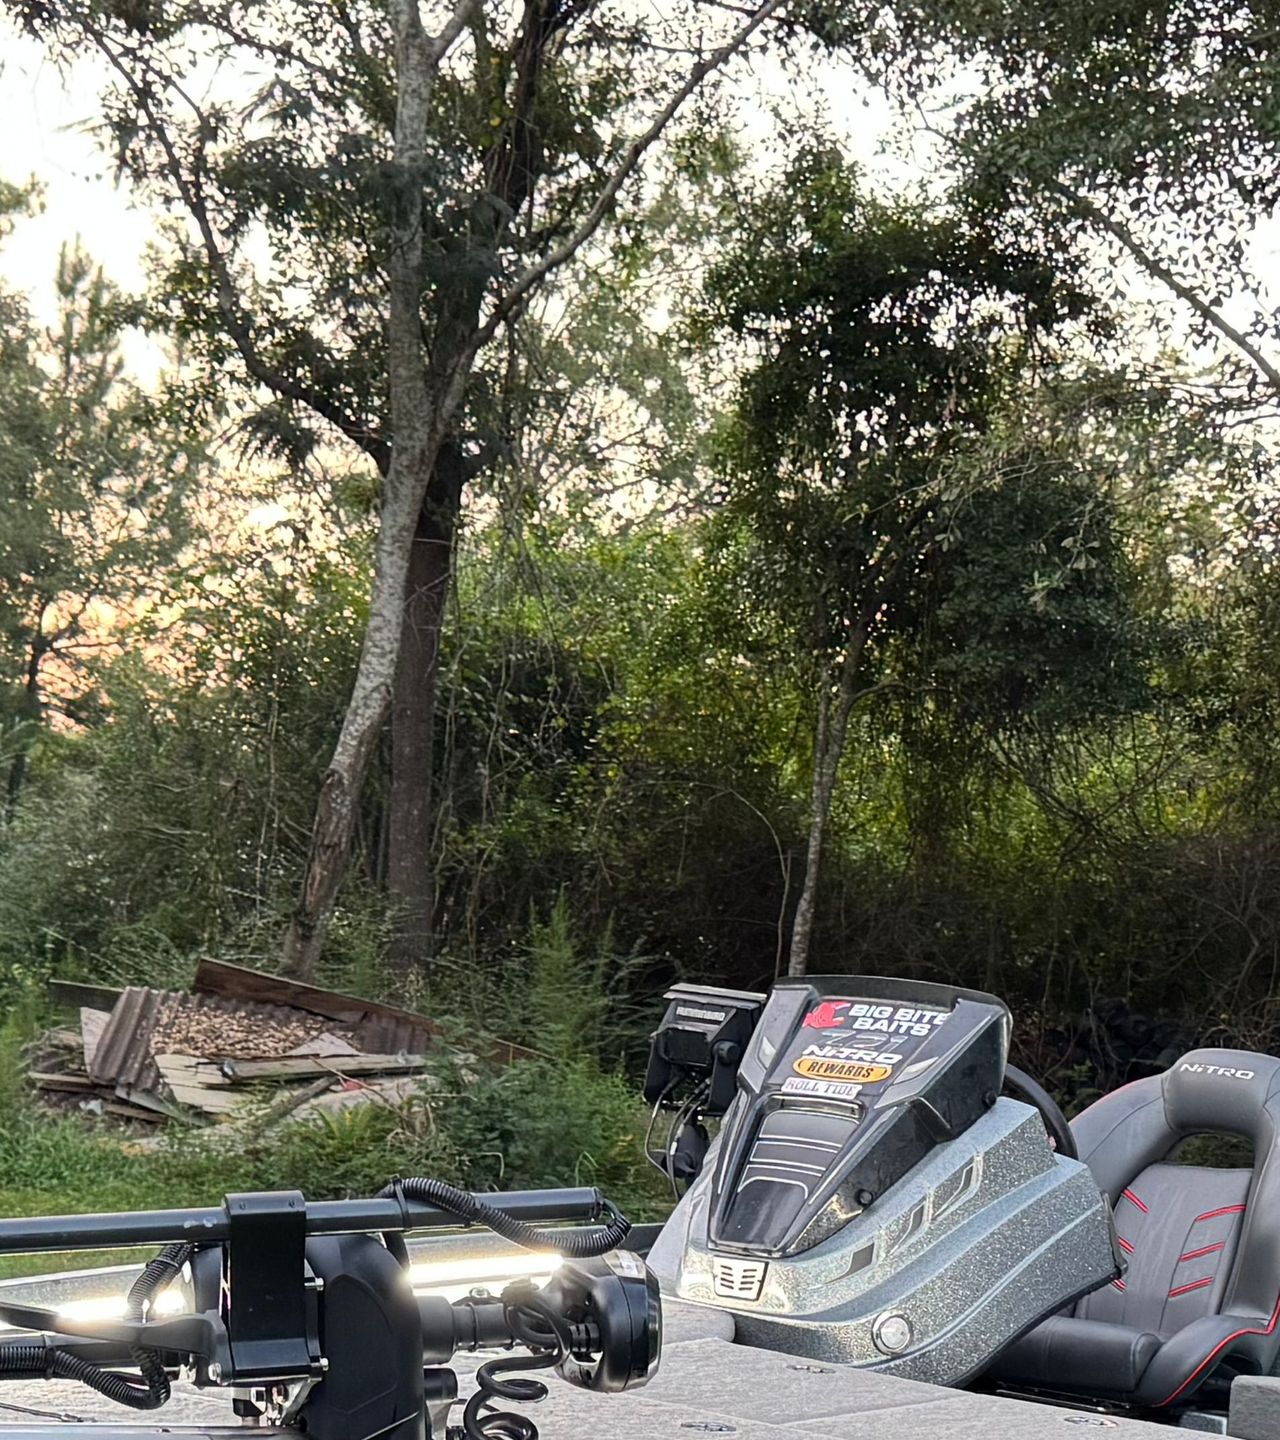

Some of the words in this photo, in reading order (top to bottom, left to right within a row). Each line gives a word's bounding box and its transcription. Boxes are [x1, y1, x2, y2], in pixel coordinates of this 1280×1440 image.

[848, 1004, 895, 1019] BIG
[894, 1007, 952, 1026] BITE
[852, 1017, 932, 1037] BAITS
[806, 1060, 875, 1079] REWARDS
